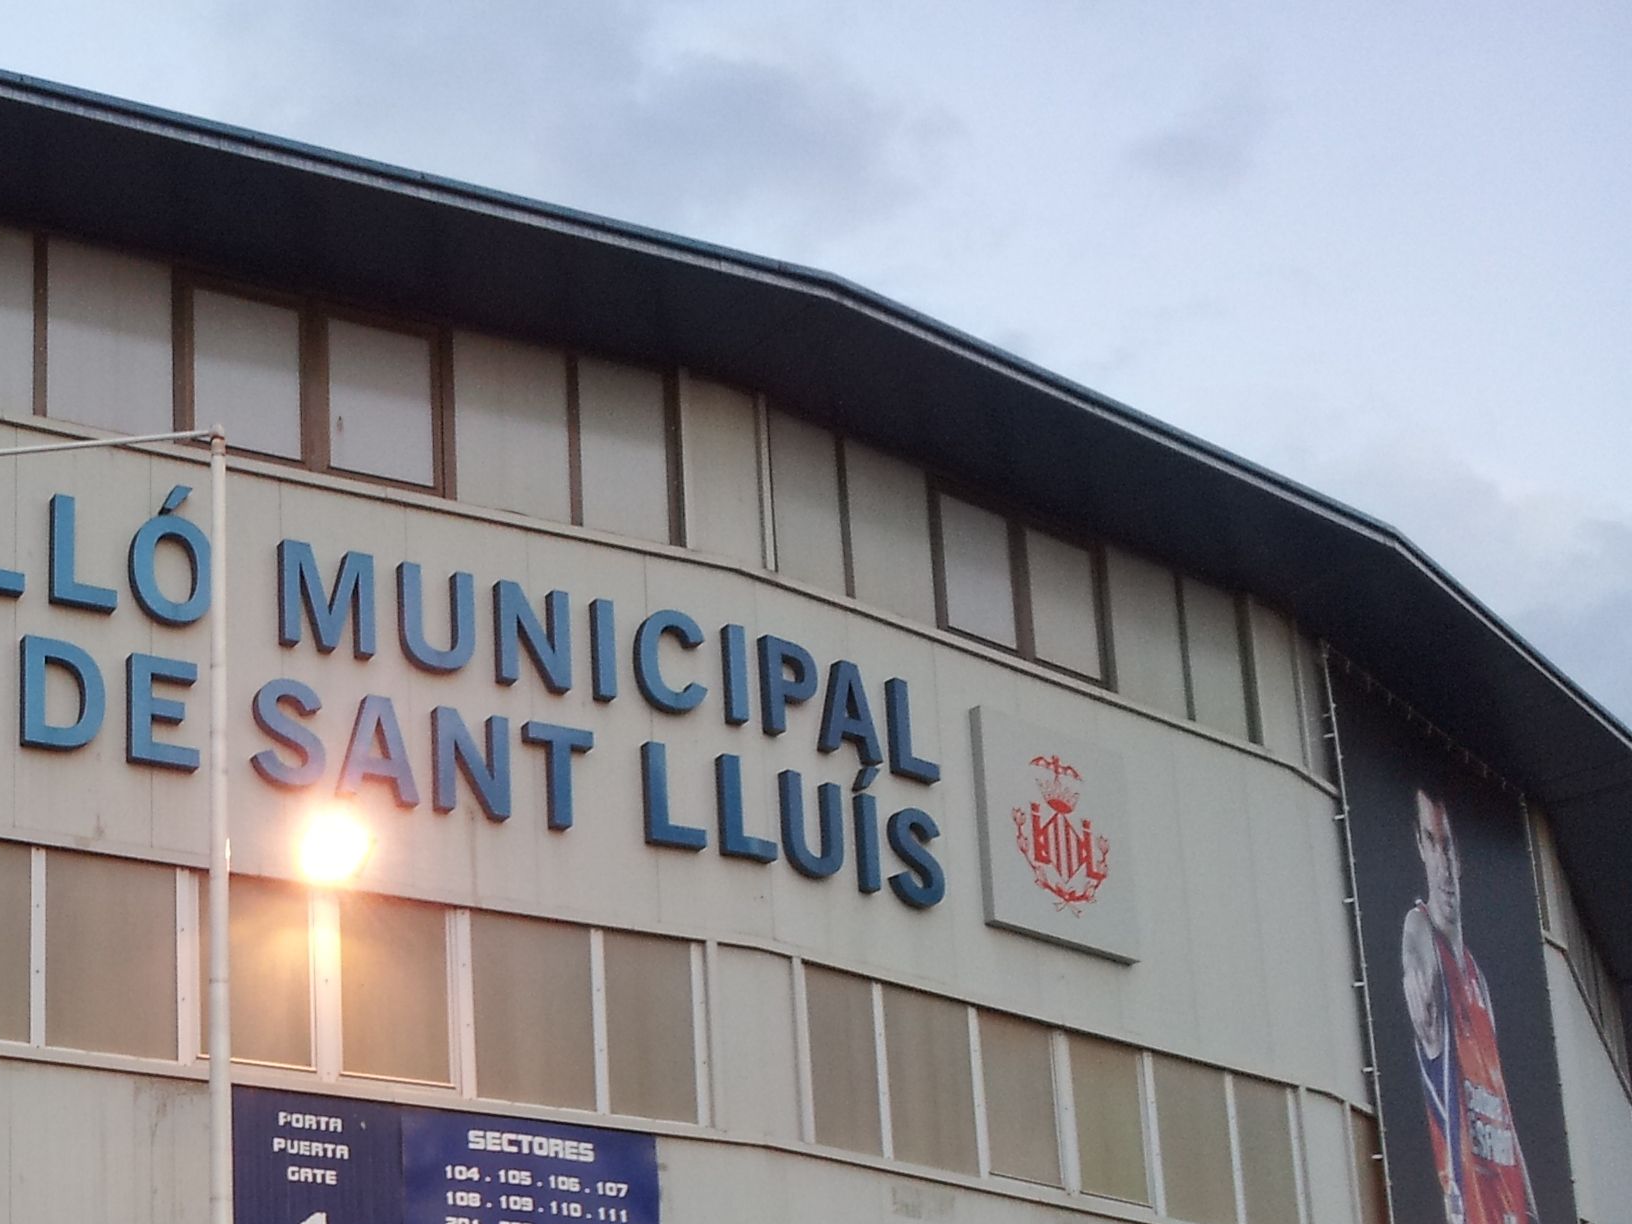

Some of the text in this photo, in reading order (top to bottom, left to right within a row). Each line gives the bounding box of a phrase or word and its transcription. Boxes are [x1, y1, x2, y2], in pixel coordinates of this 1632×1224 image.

[276, 539, 941, 786] MUNICIPAL
[19, 634, 200, 773] DE
[250, 677, 595, 832] SANT
[640, 741, 945, 909] LLUÍS
[278, 1111, 343, 1133] PORTA
[273, 1137, 349, 1160] PUERTA
[468, 1130, 595, 1162] SECTORES
[287, 1166, 338, 1185] GATE
[445, 1165, 628, 1198] 104 105 106 107
[446, 1191, 628, 1223] 108 109 110 111
